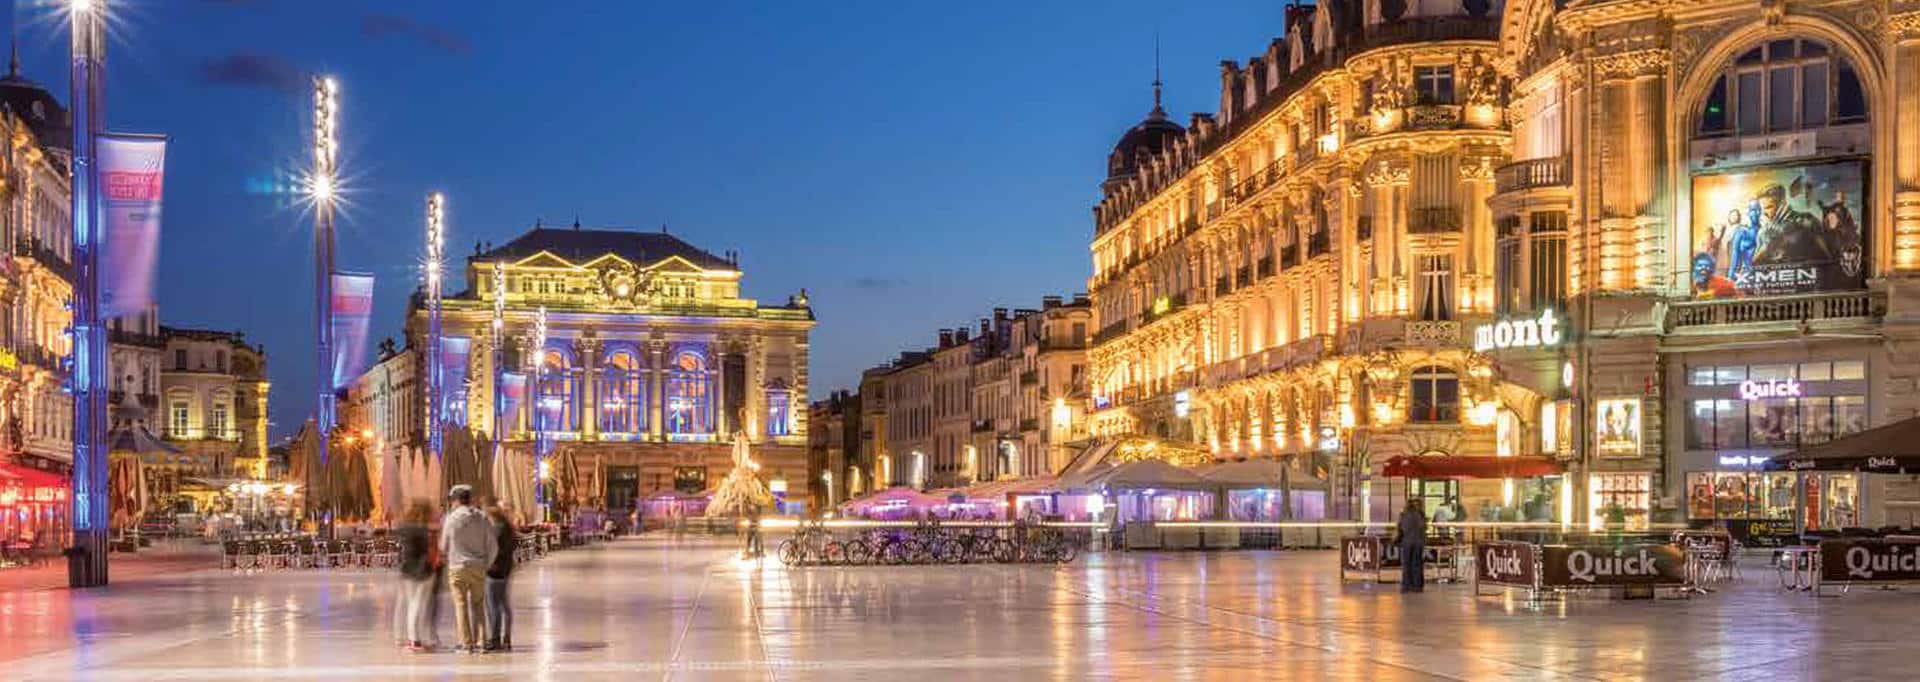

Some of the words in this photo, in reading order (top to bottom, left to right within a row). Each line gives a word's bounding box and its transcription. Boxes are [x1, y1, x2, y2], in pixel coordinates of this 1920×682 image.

[1734, 268, 1817, 284] X-MEN
[1740, 378, 1801, 400] Quick
[1868, 456, 1896, 467] Quick
[1347, 541, 1371, 567] Quick
[1486, 549, 1522, 579] Quick
[1567, 549, 1659, 582] Quick
